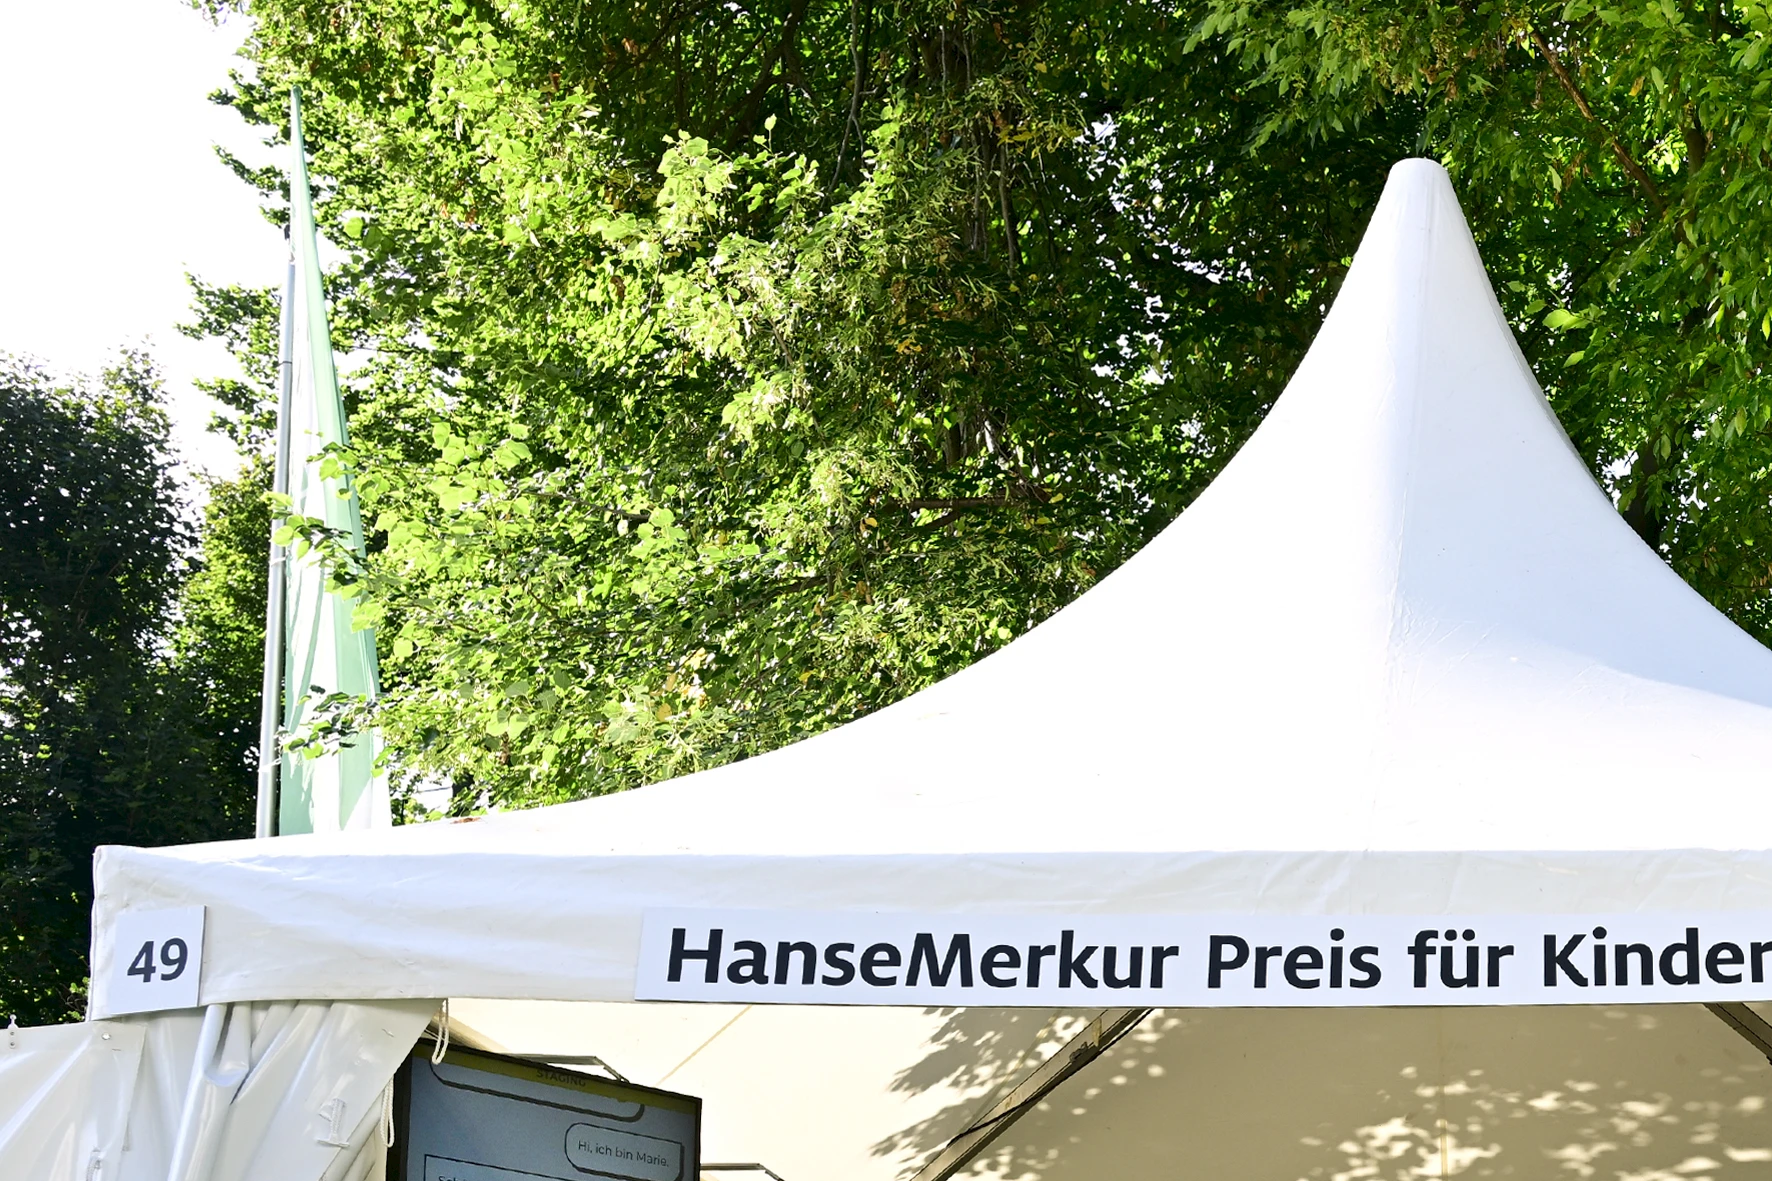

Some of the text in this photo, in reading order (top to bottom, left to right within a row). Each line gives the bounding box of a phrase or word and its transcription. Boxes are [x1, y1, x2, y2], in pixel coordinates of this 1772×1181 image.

[127, 937, 188, 983] 49
[666, 927, 1180, 989] HanseMerkur
[1207, 927, 1382, 989] Preis
[1407, 929, 1514, 988] für
[578, 1140, 669, 1167] Hi, ich bin Marie.
